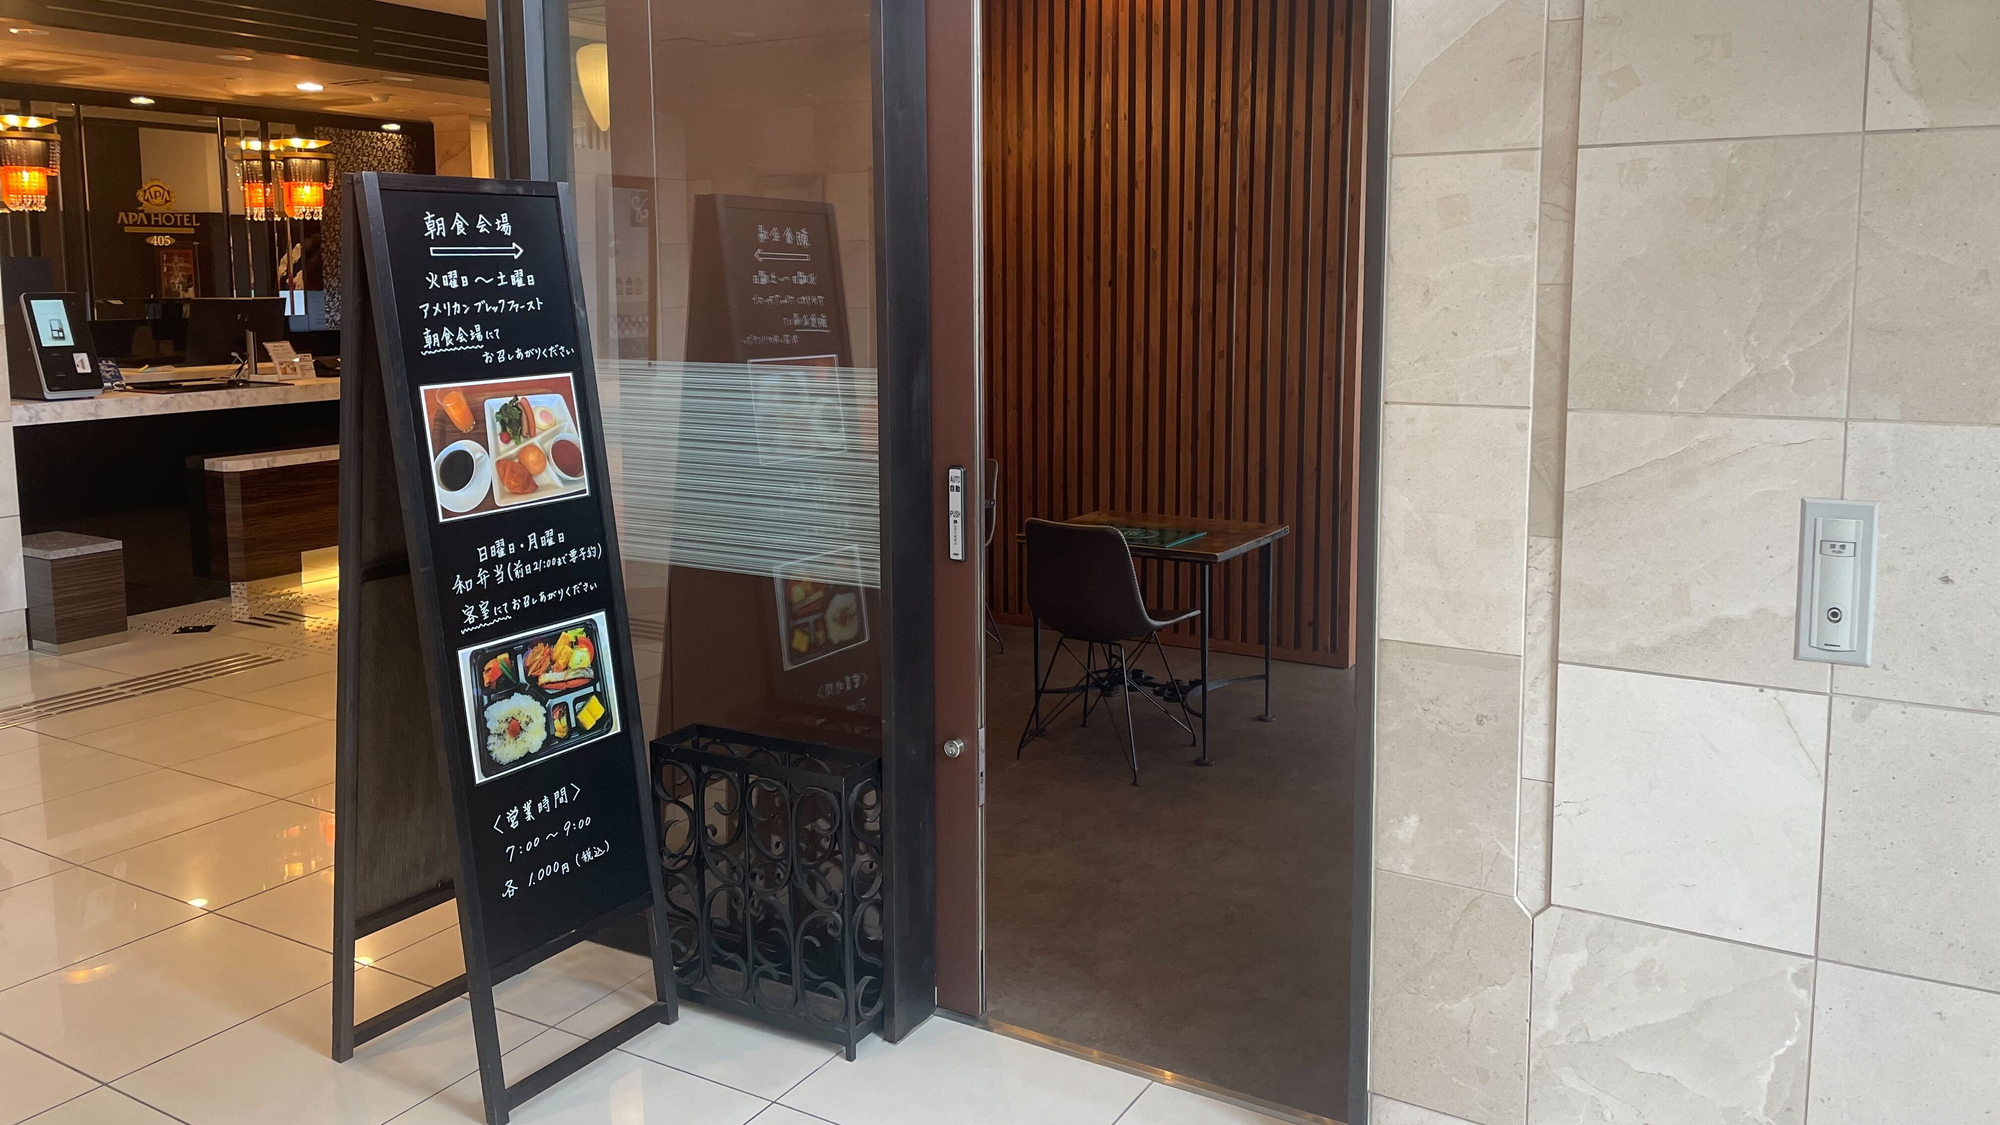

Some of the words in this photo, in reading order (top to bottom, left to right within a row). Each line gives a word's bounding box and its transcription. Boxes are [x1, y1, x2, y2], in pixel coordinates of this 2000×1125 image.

[117, 211, 148, 225] APA
[151, 213, 201, 227] HOTEL
[423, 211, 512, 240] 朝食会場
[150, 235, 171, 247] 405
[422, 324, 501, 349] 朝食会場にて
[482, 344, 575, 364] お召しあがりください
[477, 528, 565, 563] 日曜日・月曜日
[501, 879, 519, 899] 各
